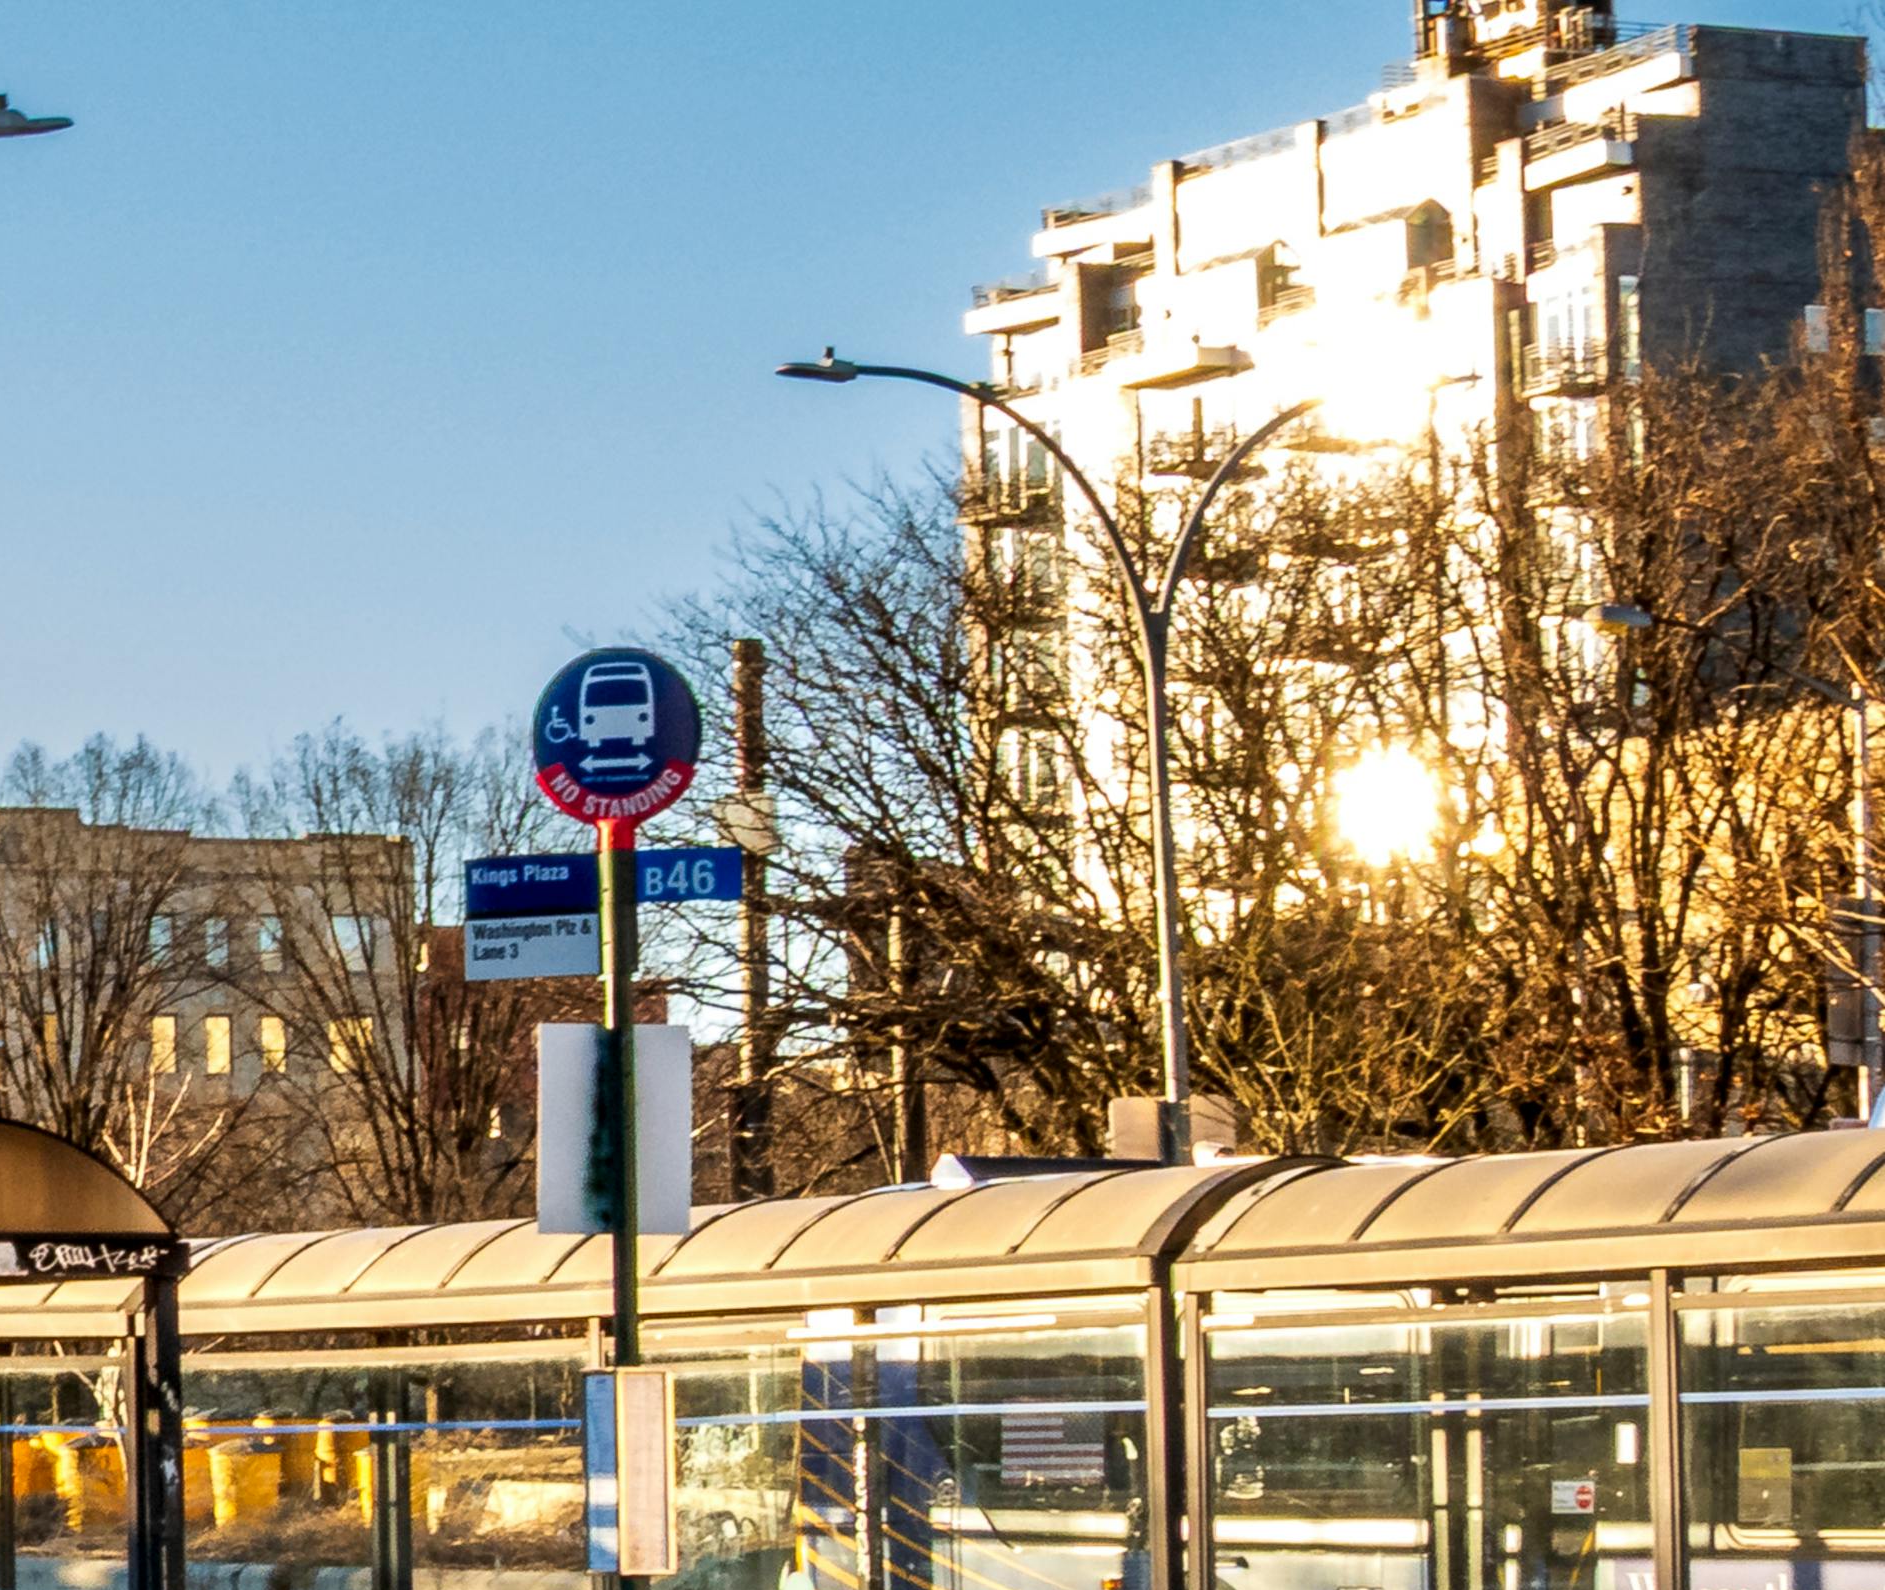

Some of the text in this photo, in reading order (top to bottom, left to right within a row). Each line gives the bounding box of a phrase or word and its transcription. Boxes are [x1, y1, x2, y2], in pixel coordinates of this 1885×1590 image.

[549, 768, 683, 818] NO STANDING
[471, 864, 569, 888] Kings Plaza
[644, 859, 716, 897] B46
[472, 922, 552, 942] Washington
[556, 919, 577, 935] Plz
[473, 942, 519, 961] Lane 3
